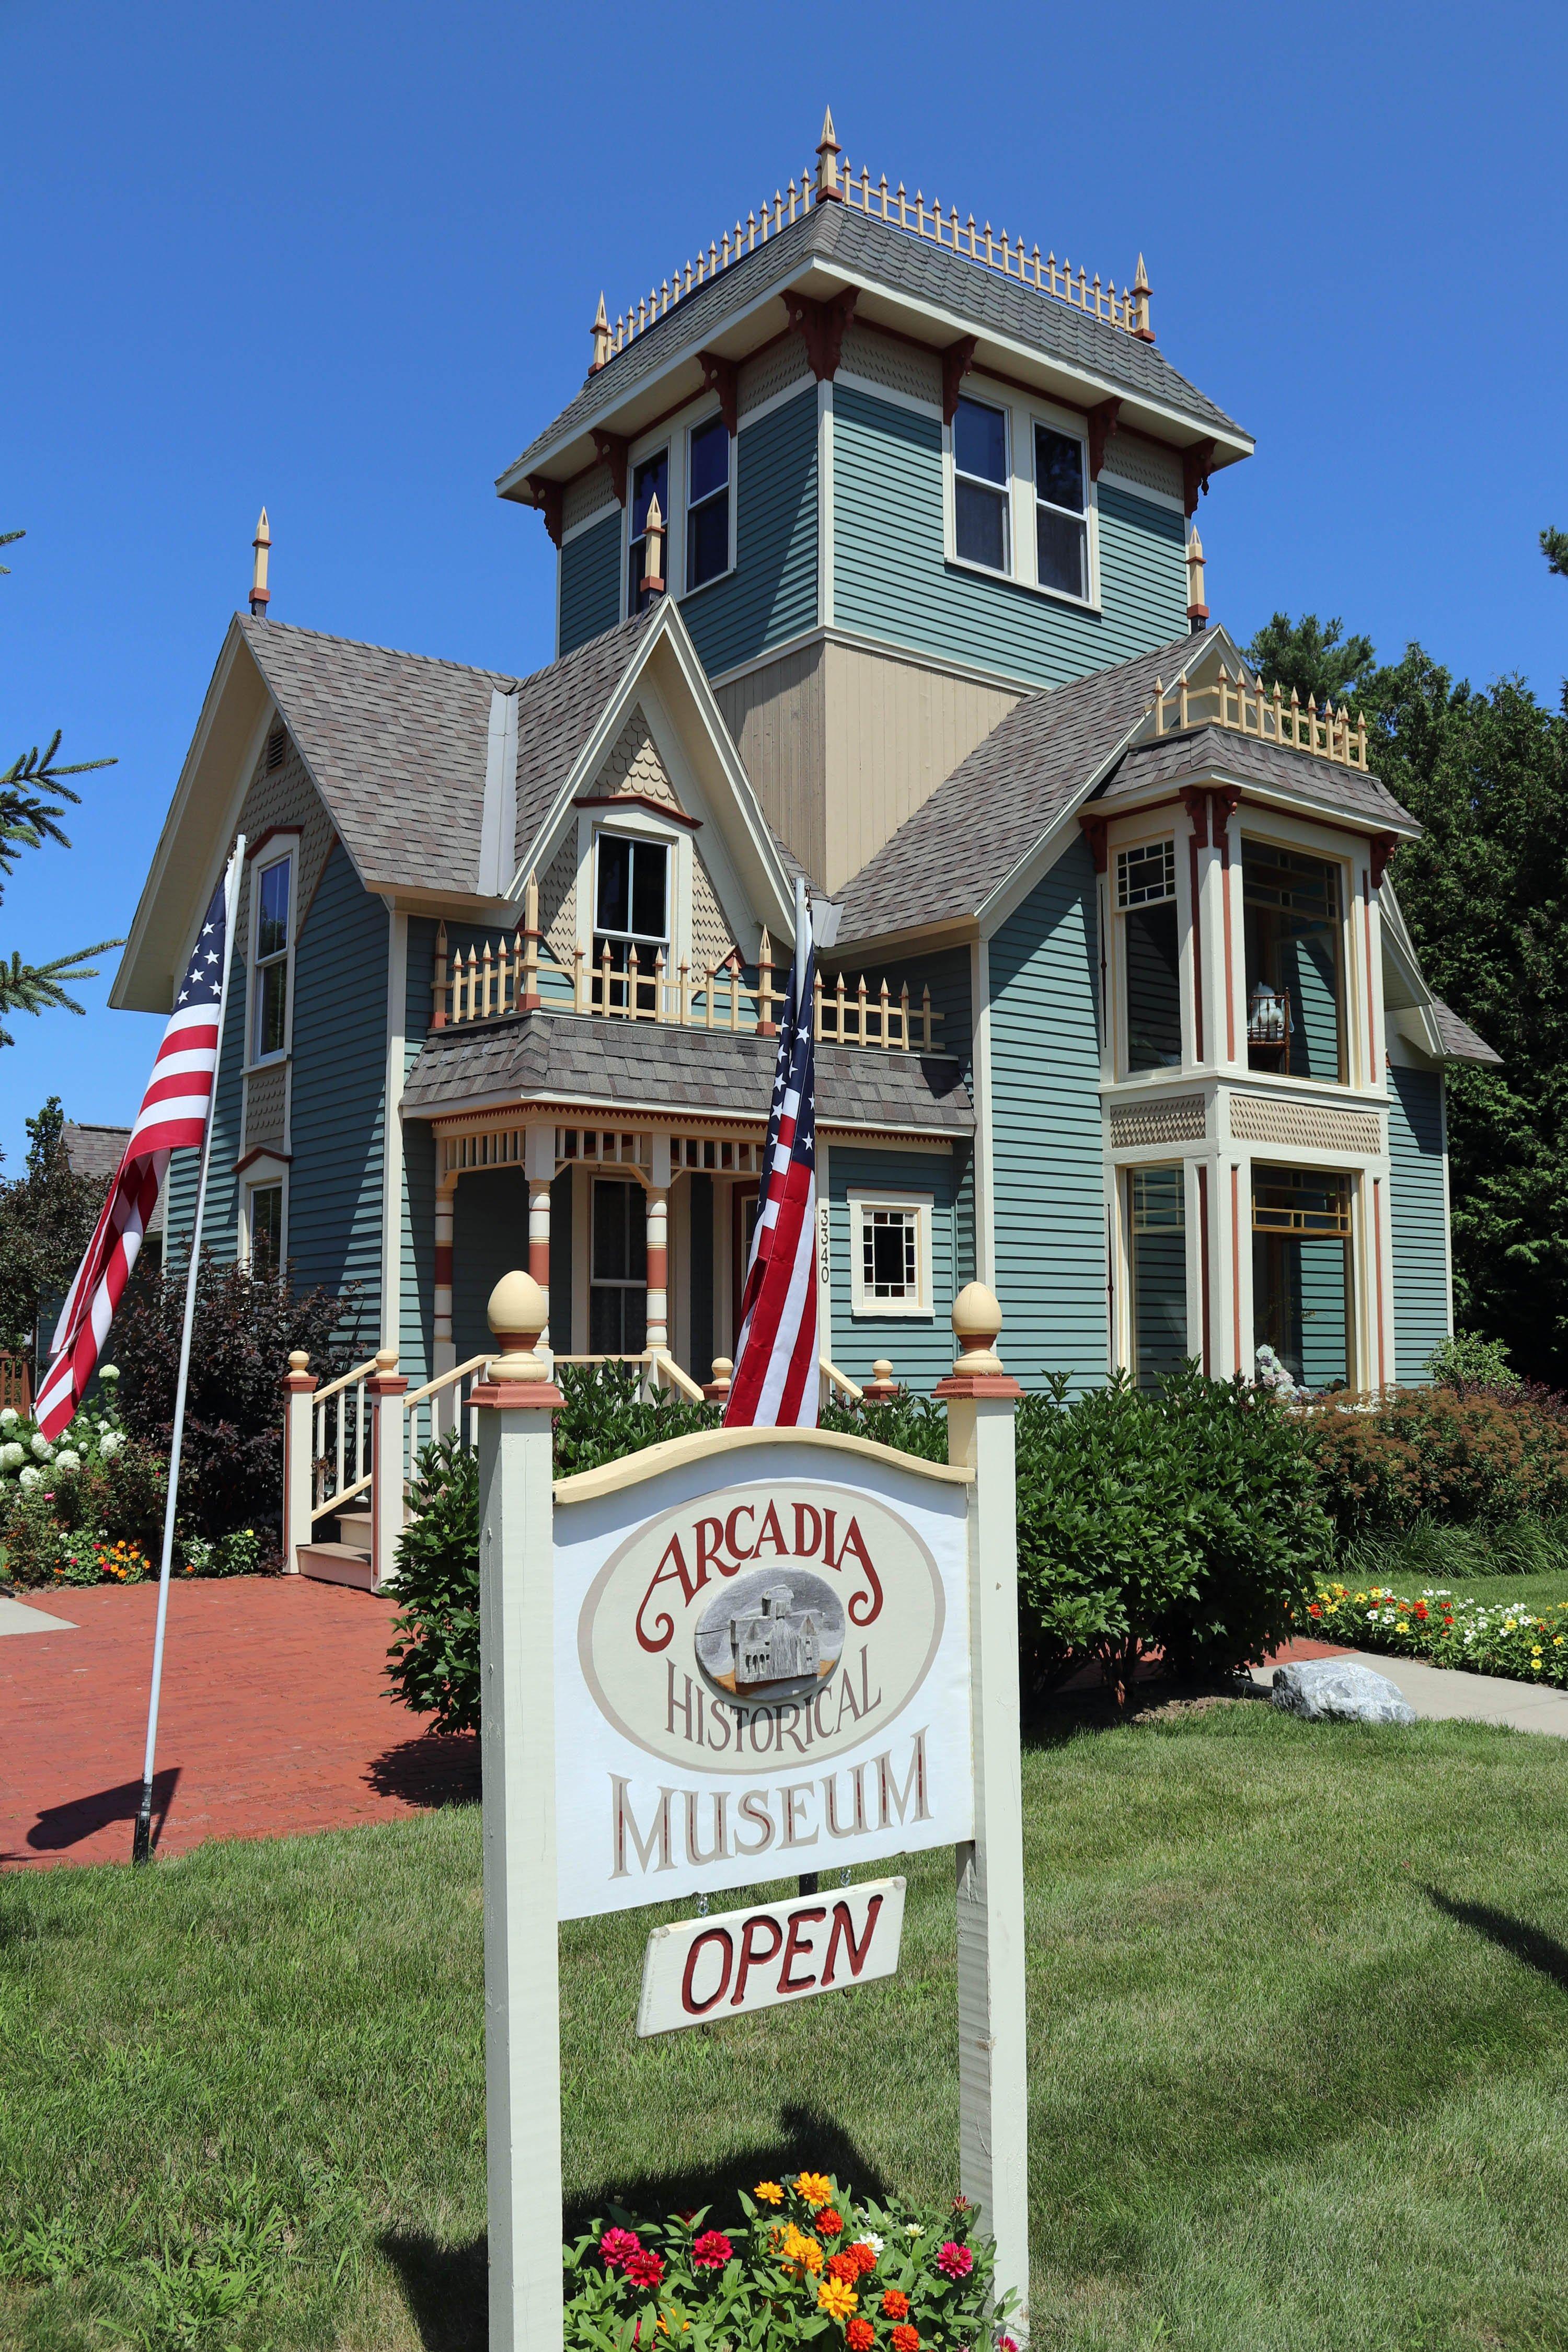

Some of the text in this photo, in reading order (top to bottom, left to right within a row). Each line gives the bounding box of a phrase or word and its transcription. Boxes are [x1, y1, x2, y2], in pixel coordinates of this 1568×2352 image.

[821, 1209, 829, 1284] 3340
[636, 1498, 884, 1653] ARCADIA
[665, 1644, 882, 1753] HISTORICAL
[608, 1726, 934, 1880] MUSEUM
[682, 1894, 884, 2015] OPEN
